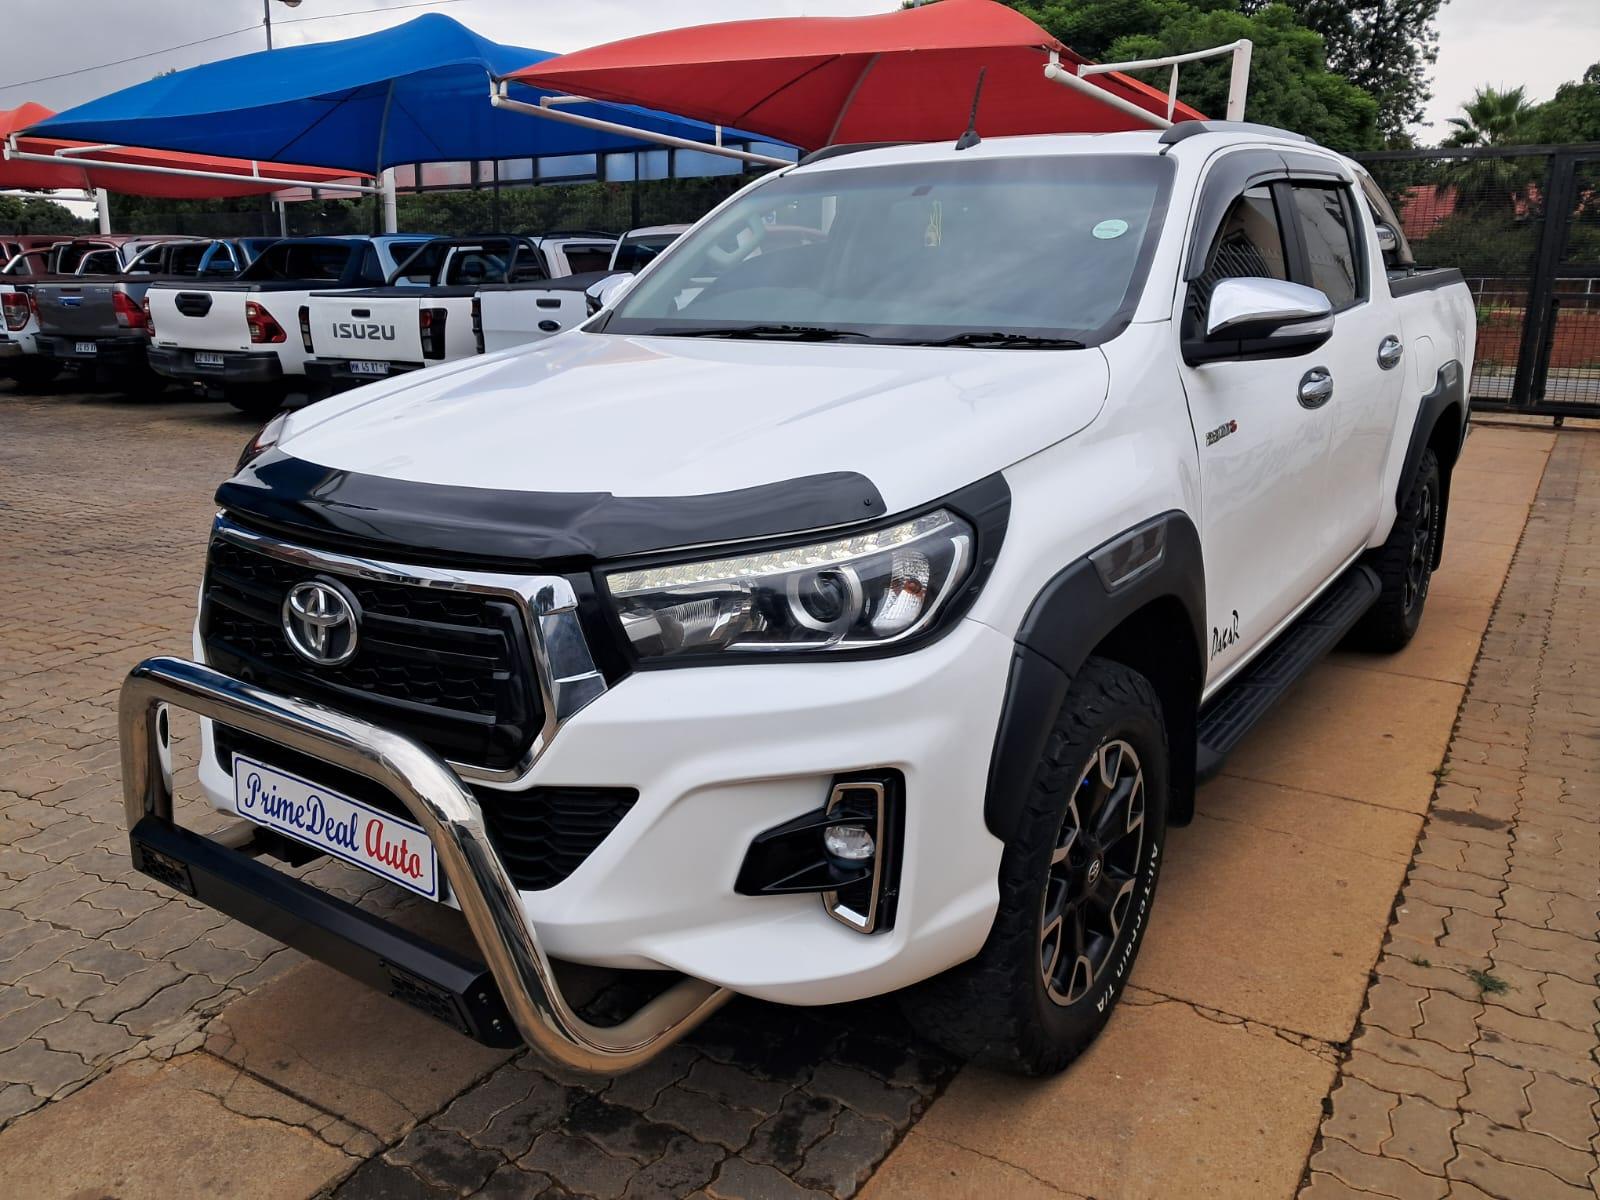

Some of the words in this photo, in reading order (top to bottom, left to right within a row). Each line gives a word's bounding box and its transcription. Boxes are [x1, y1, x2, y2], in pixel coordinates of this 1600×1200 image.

[333, 323, 395, 340] ISUZU
[244, 772, 360, 852] PrimeDeal
[365, 818, 424, 880] Auto
[1096, 983, 1116, 1013] T/A
